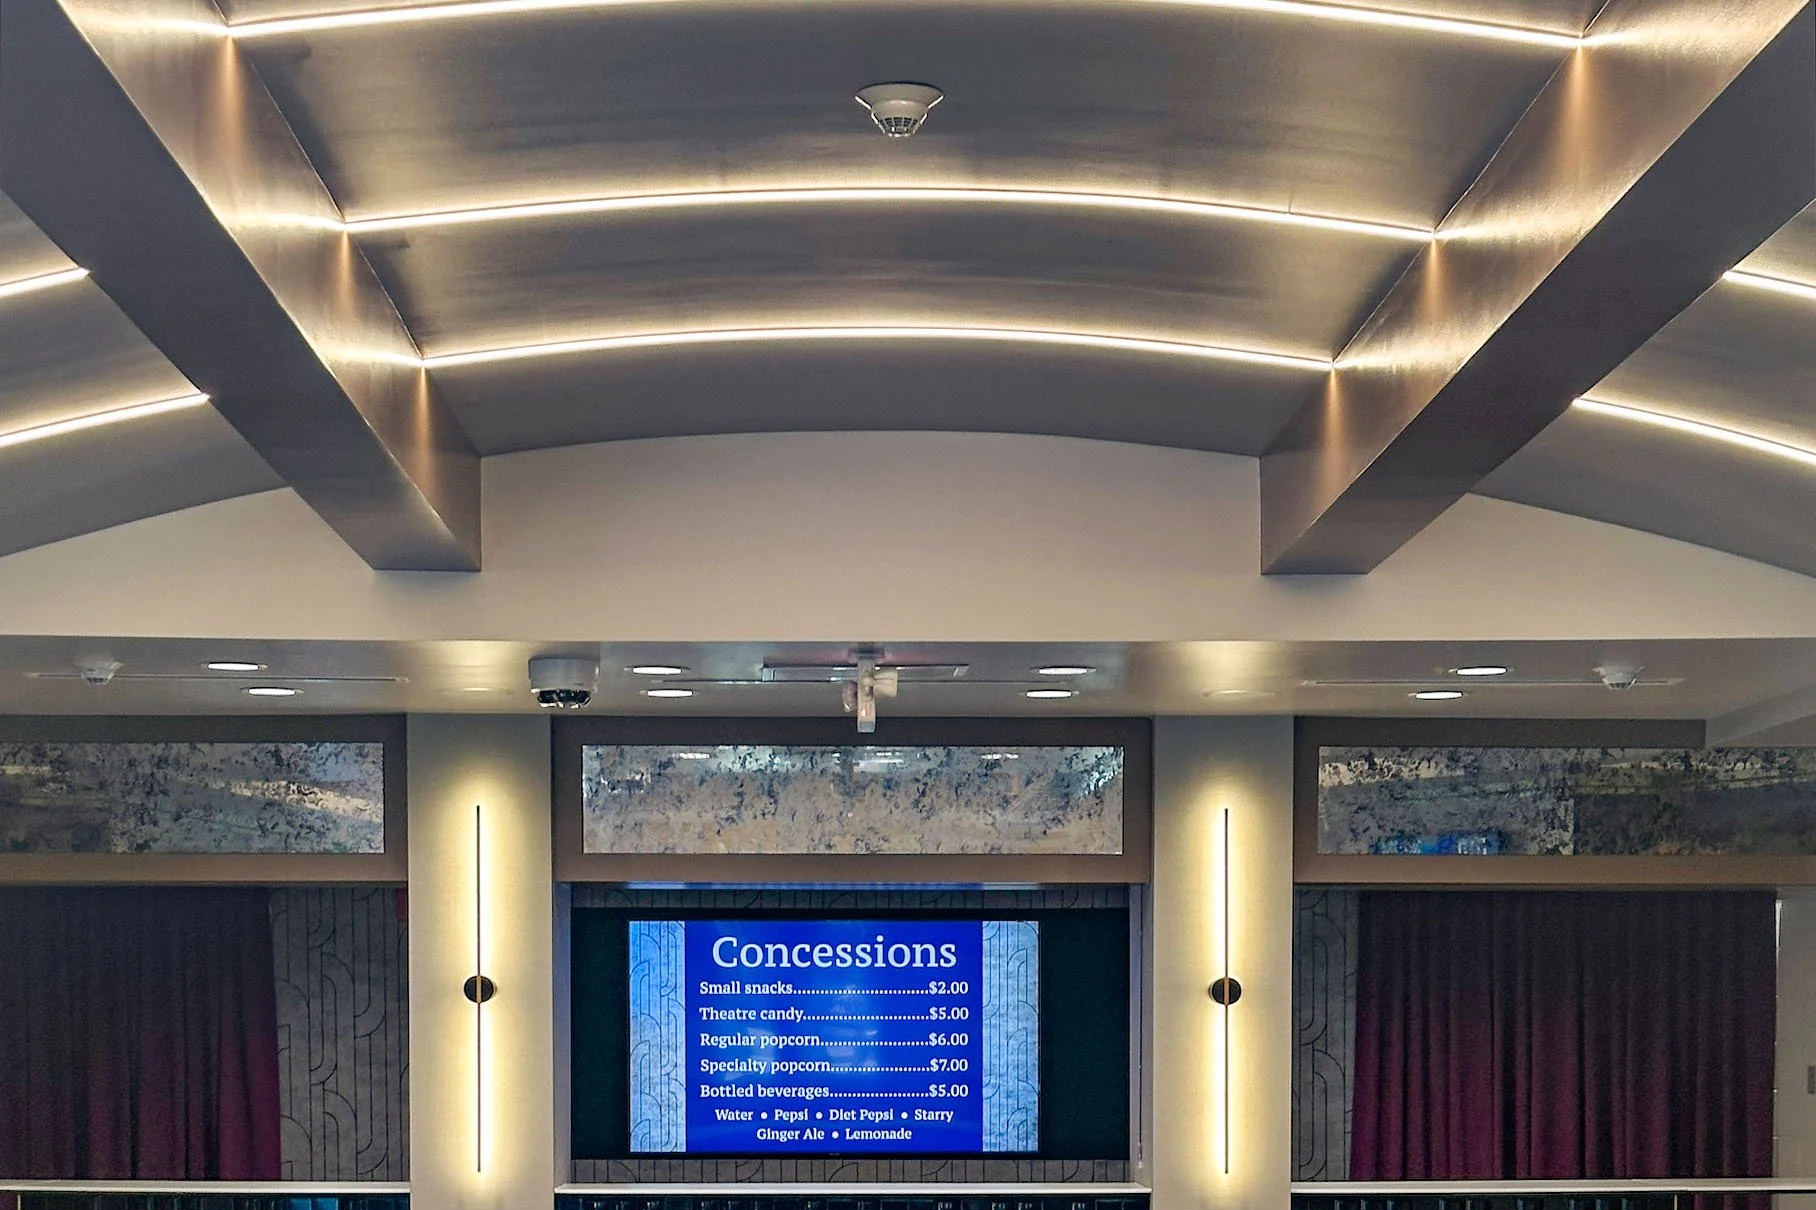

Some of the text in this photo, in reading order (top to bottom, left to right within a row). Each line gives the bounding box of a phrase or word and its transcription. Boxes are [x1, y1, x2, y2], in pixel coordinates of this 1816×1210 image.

[712, 935, 957, 968] Concessions
[699, 980, 741, 995] Small
[928, 981, 969, 995] $2.00
[699, 1006, 757, 1021] Theatre
[929, 1006, 969, 1021] $5.00
[700, 1032, 757, 1049] Regular
[928, 1032, 969, 1047] $6.00
[700, 1058, 767, 1075] Specialty
[930, 1057, 969, 1073] $7.00
[700, 1083, 754, 1098] Bottled
[928, 1083, 969, 1098] $5.00
[714, 1108, 954, 1124] Water Pepsi Diet Pepsi Starry
[756, 1127, 913, 1143] Ginger Ale Lemonade
